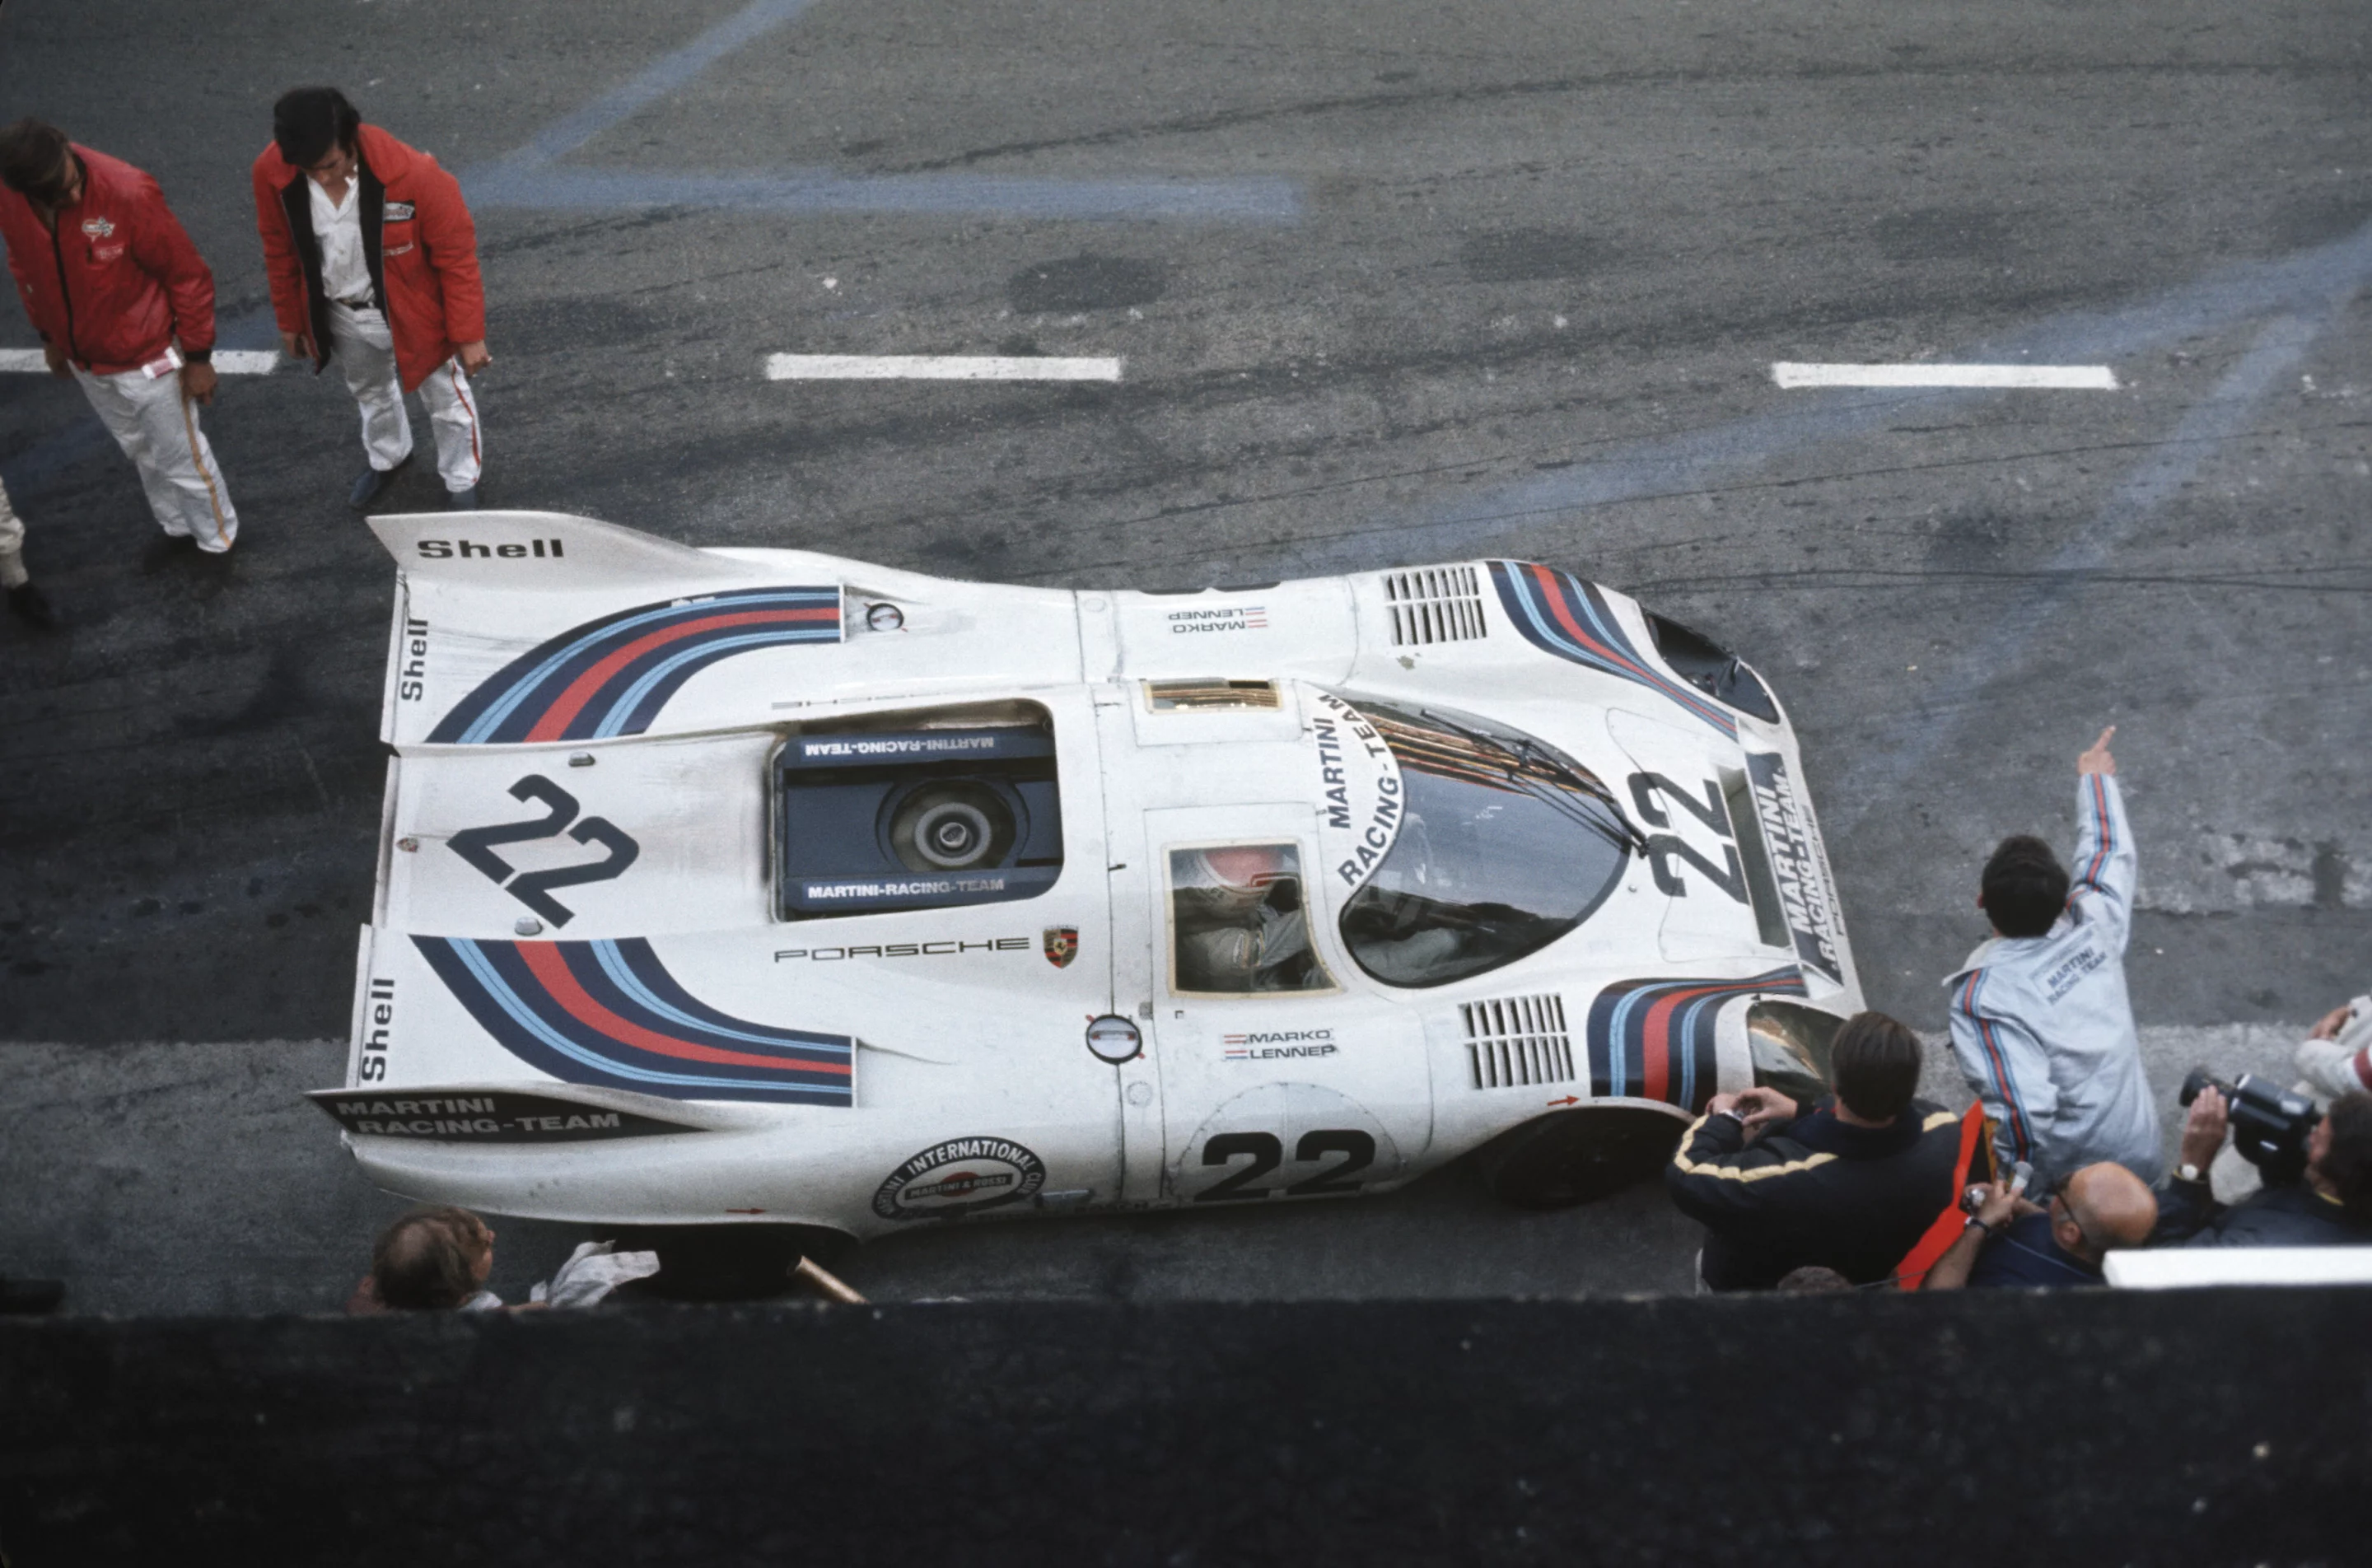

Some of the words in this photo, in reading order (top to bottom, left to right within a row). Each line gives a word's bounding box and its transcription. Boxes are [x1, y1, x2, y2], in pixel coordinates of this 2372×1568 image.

[418, 539, 563, 558] Shell
[1168, 608, 1244, 620] LENNEP
[1172, 620, 1245, 633] MARKO
[401, 619, 428, 702] Shell
[1313, 717, 1351, 829] MARTINI
[445, 774, 640, 930] 22
[1627, 772, 1751, 907] 22
[1755, 785, 1814, 935] MARTINI
[807, 879, 1005, 898] MARTINI-RACING-TEAM
[774, 937, 1030, 963] PORSCHE
[2047, 946, 2094, 988] MARTINI
[361, 979, 395, 1082] Shell
[1249, 1029, 1331, 1043] MARKO
[1249, 1044, 1338, 1060] LENNEP
[336, 1098, 496, 1115] MARTINI
[907, 1140, 1038, 1176] INTERNATIONAL
[1194, 1129, 1376, 1202] 22
[974, 1176, 1007, 1188] ROSSI
